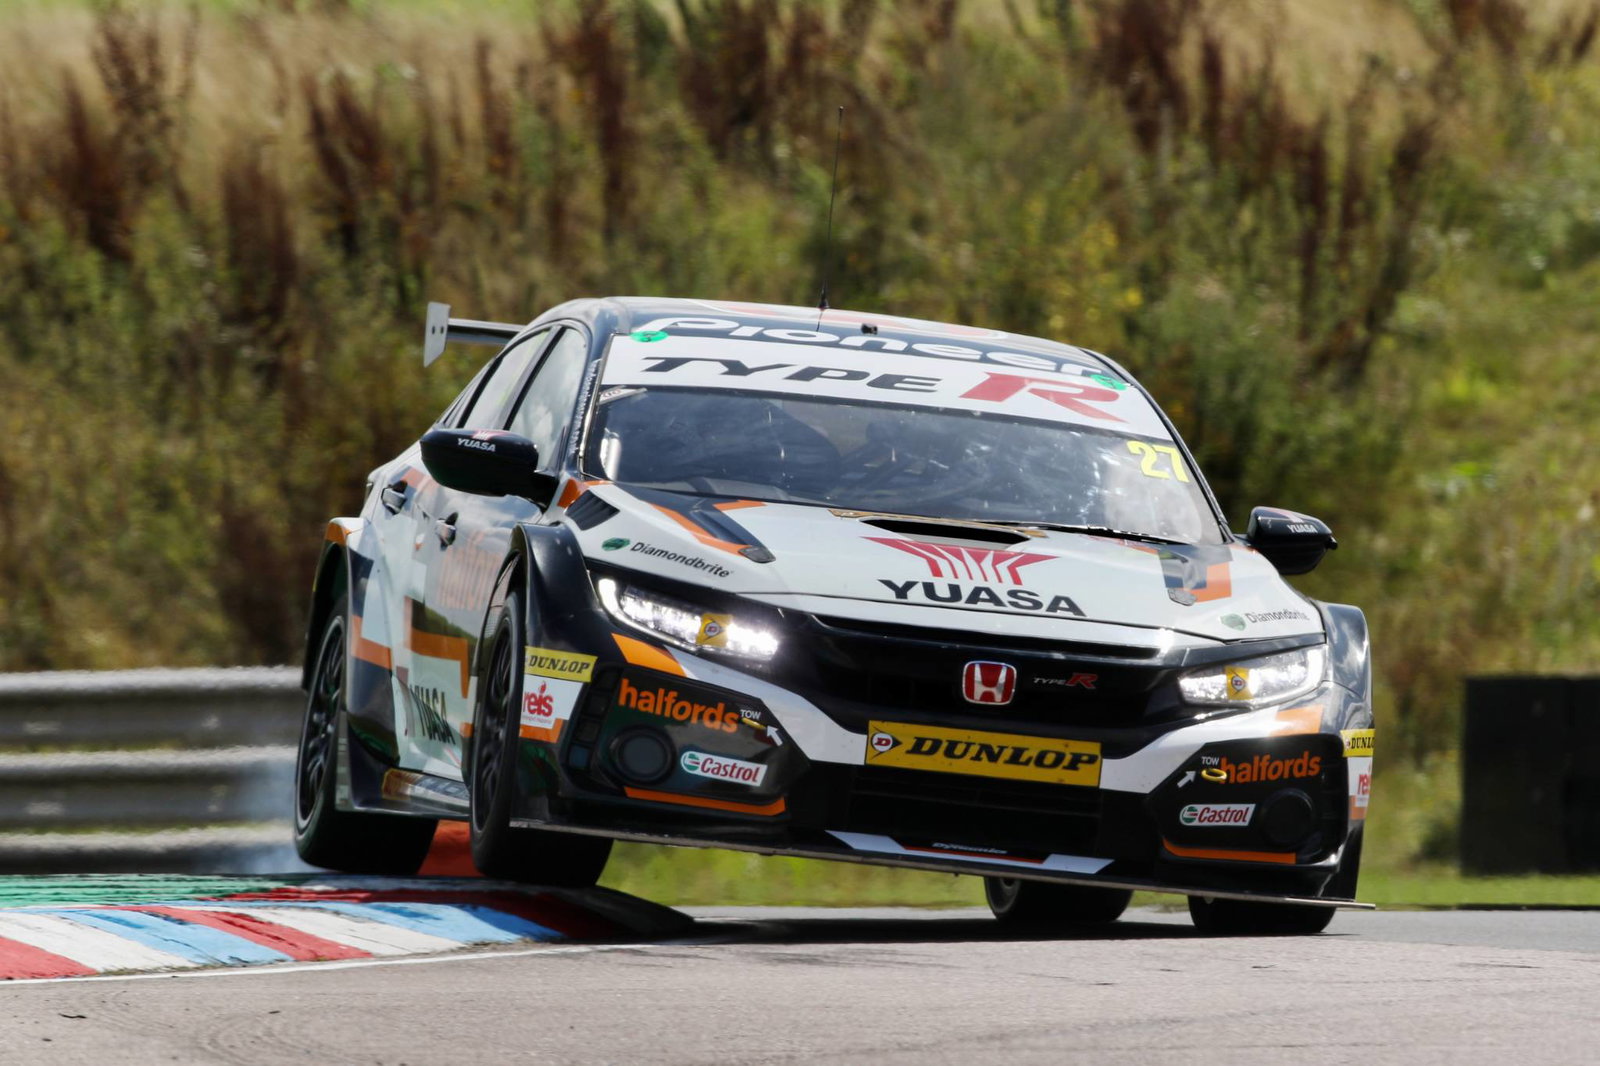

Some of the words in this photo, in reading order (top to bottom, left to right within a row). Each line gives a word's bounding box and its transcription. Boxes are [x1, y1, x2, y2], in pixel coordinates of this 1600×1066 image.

[641, 357, 942, 393] TYPE
[959, 371, 1130, 424] R
[457, 438, 496, 453] YUASA
[1126, 440, 1190, 483] 27
[630, 541, 731, 578] Diamondbrite
[877, 579, 1088, 617] YUASA
[528, 655, 591, 674] DUNLOP
[617, 678, 740, 733] halfords
[740, 708, 761, 720] TOW
[700, 757, 762, 783] Castrol
[905, 736, 1098, 772] DUNLOP
[1201, 756, 1220, 765] TOW
[1220, 750, 1322, 784] halfords
[1198, 806, 1250, 824] Castrol
